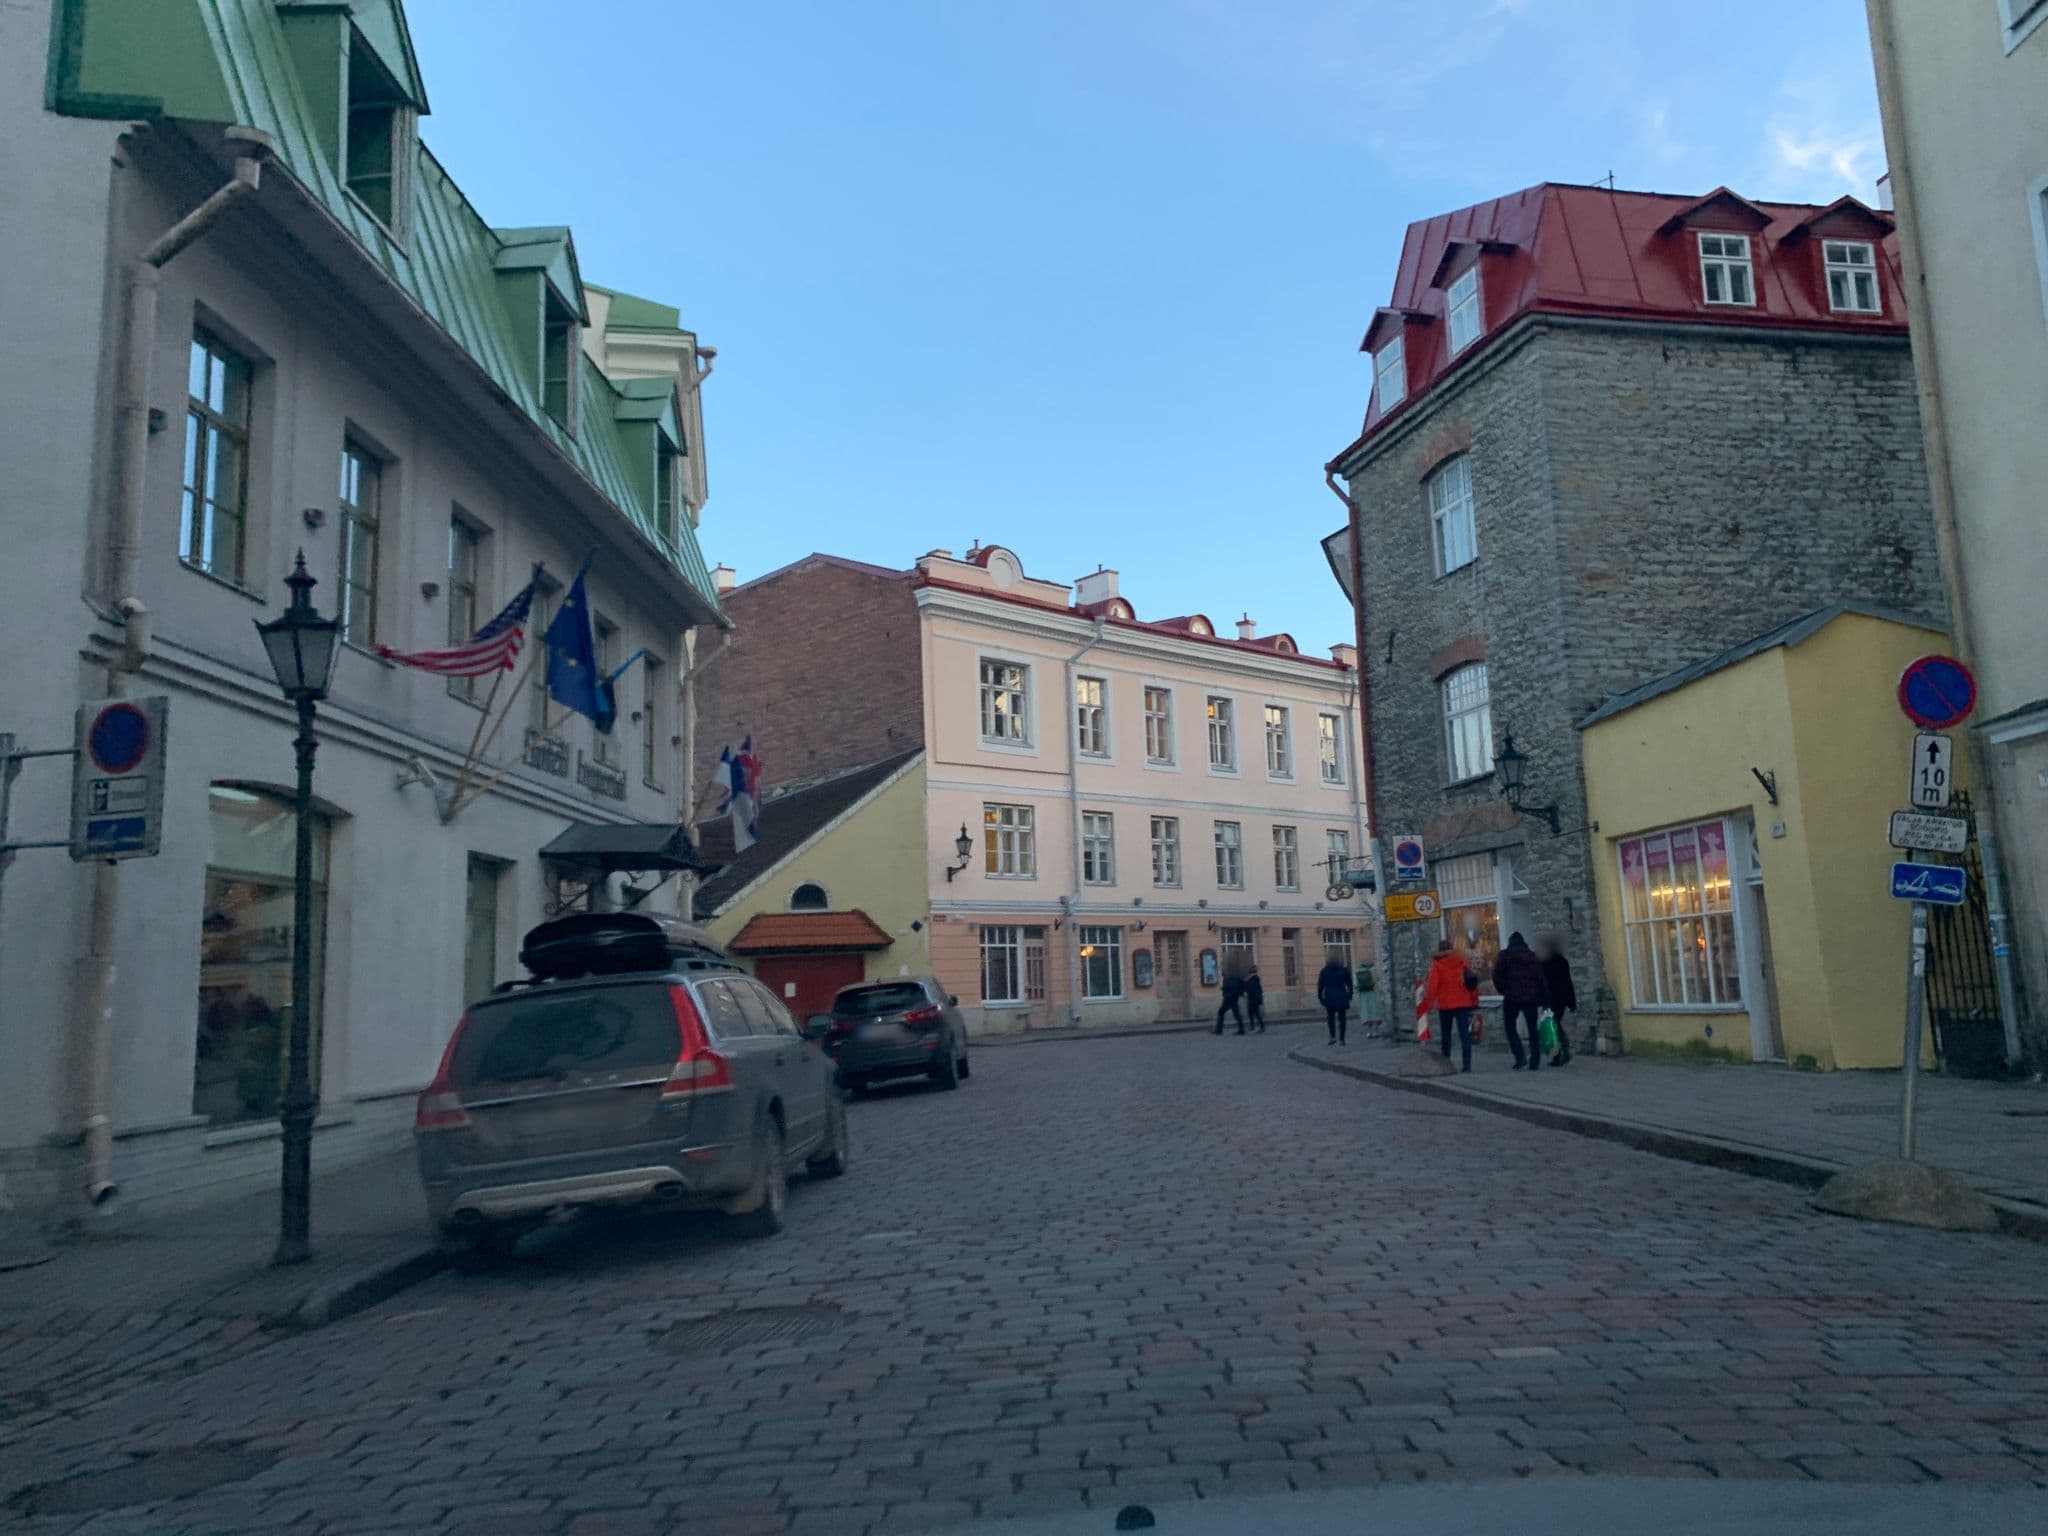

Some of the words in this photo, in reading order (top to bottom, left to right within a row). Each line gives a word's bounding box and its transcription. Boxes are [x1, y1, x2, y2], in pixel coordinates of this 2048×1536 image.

[1921, 768, 1945, 787] 10
[1922, 787, 1940, 802] m
[1417, 899, 1432, 912] 20
